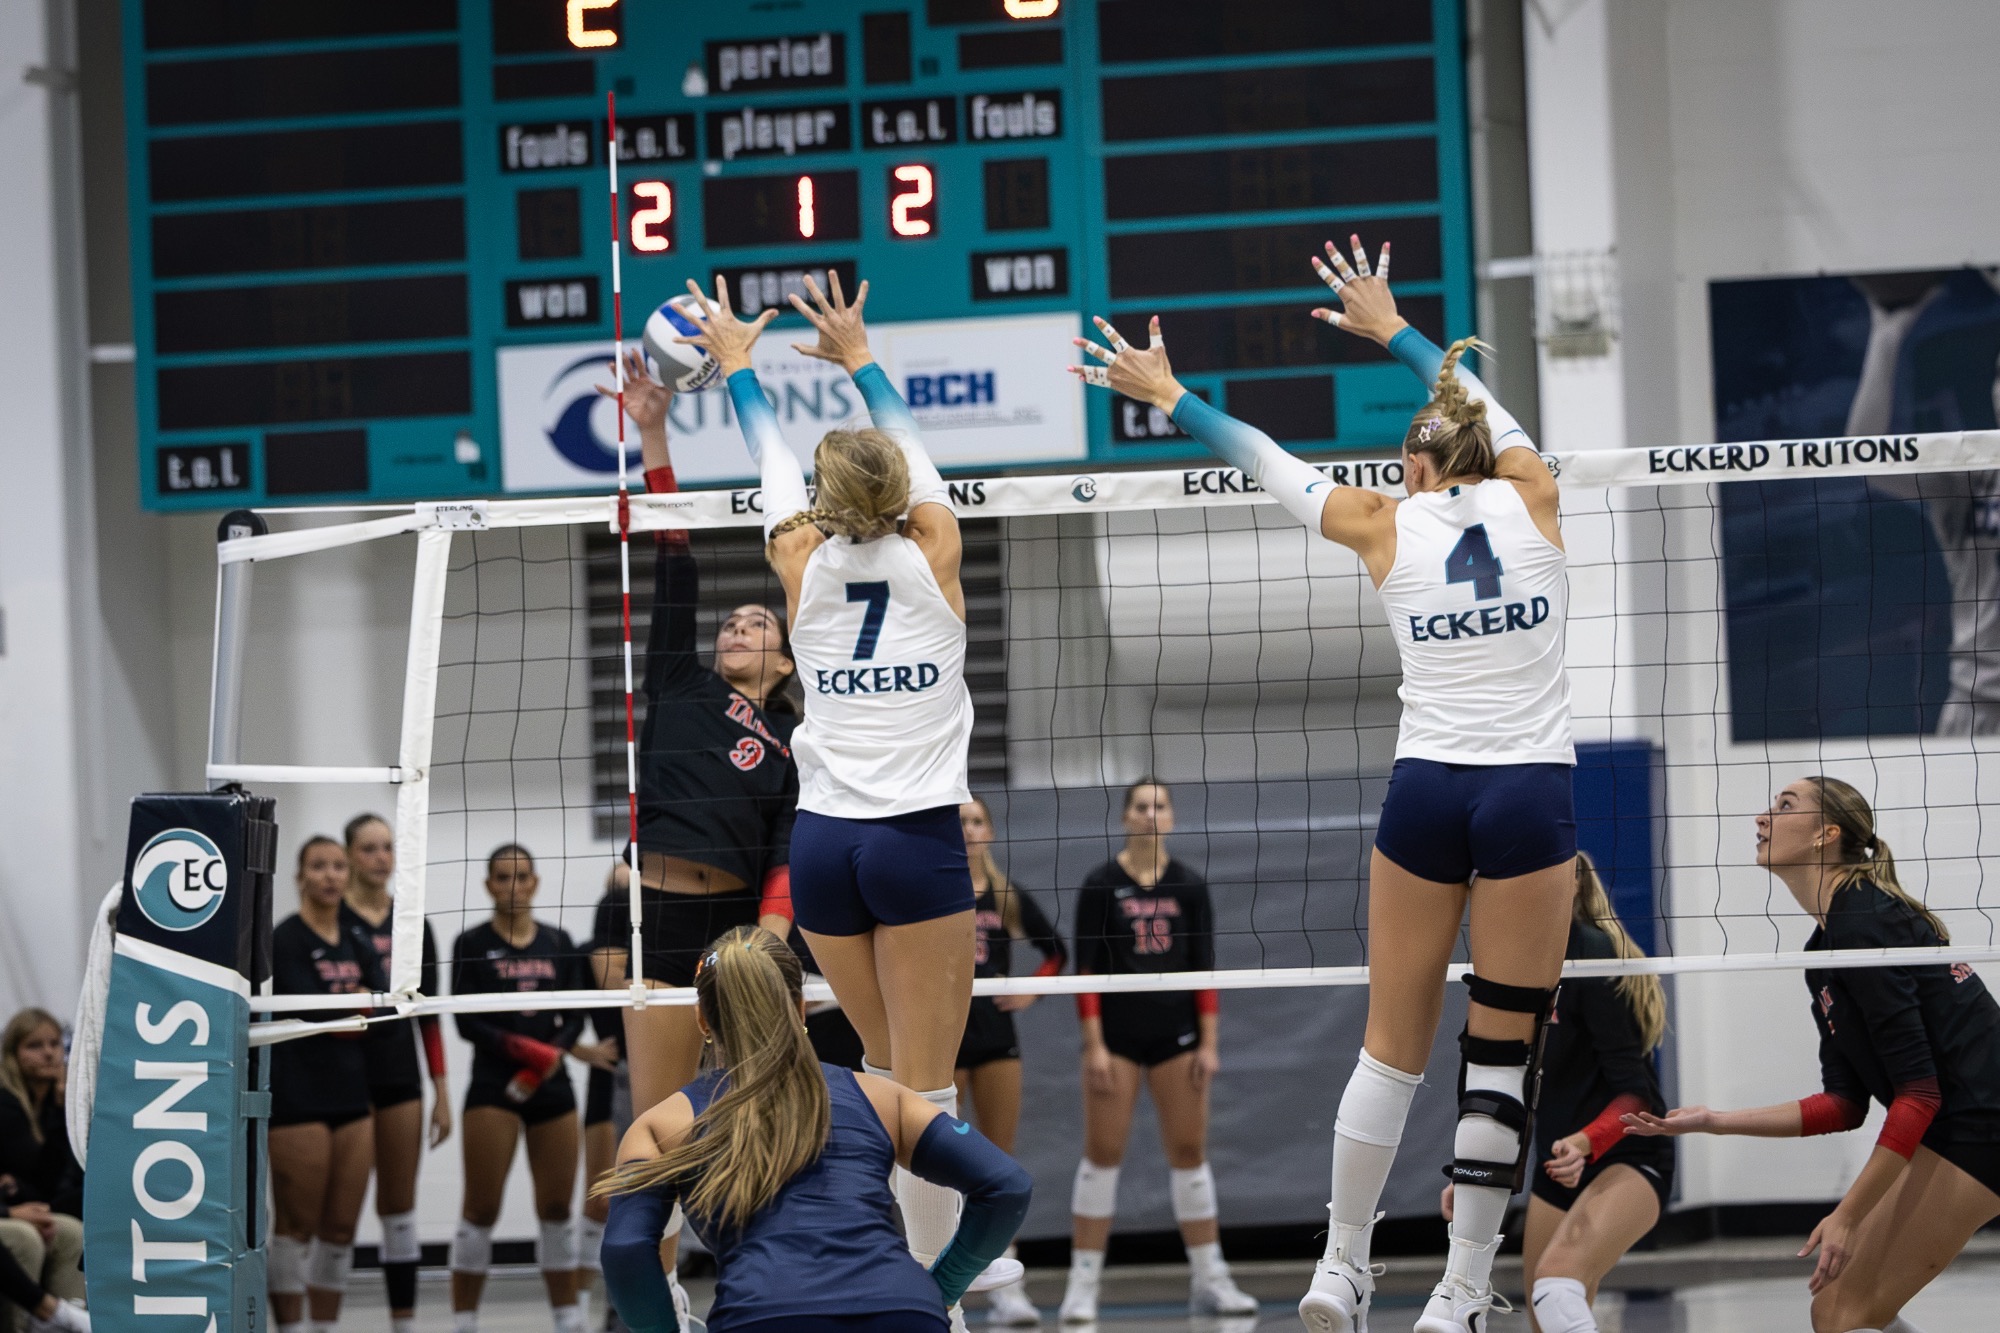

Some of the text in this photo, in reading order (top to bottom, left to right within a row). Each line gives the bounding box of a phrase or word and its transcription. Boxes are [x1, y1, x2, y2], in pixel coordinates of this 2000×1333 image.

[719, 33, 831, 91] period
[722, 107, 835, 160] player
[972, 93, 1056, 140] fouls
[507, 124, 588, 169] fouls
[631, 181, 671, 251] 2
[798, 176, 814, 237] 1
[892, 165, 932, 236] 2
[985, 253, 1054, 291] won
[518, 284, 588, 319] won
[906, 371, 996, 408] BCH
[1649, 437, 1919, 474] ECKERD TRITONS
[1184, 462, 1404, 495] ECKE RITO
[1445, 523, 1504, 601] 4
[845, 580, 890, 661] 7
[1409, 596, 1550, 641] ECKERD
[816, 663, 940, 695] ECKERD
[728, 737, 765, 771] 9
[183, 859, 224, 892] EC
[131, 1000, 217, 1333] ITONS
